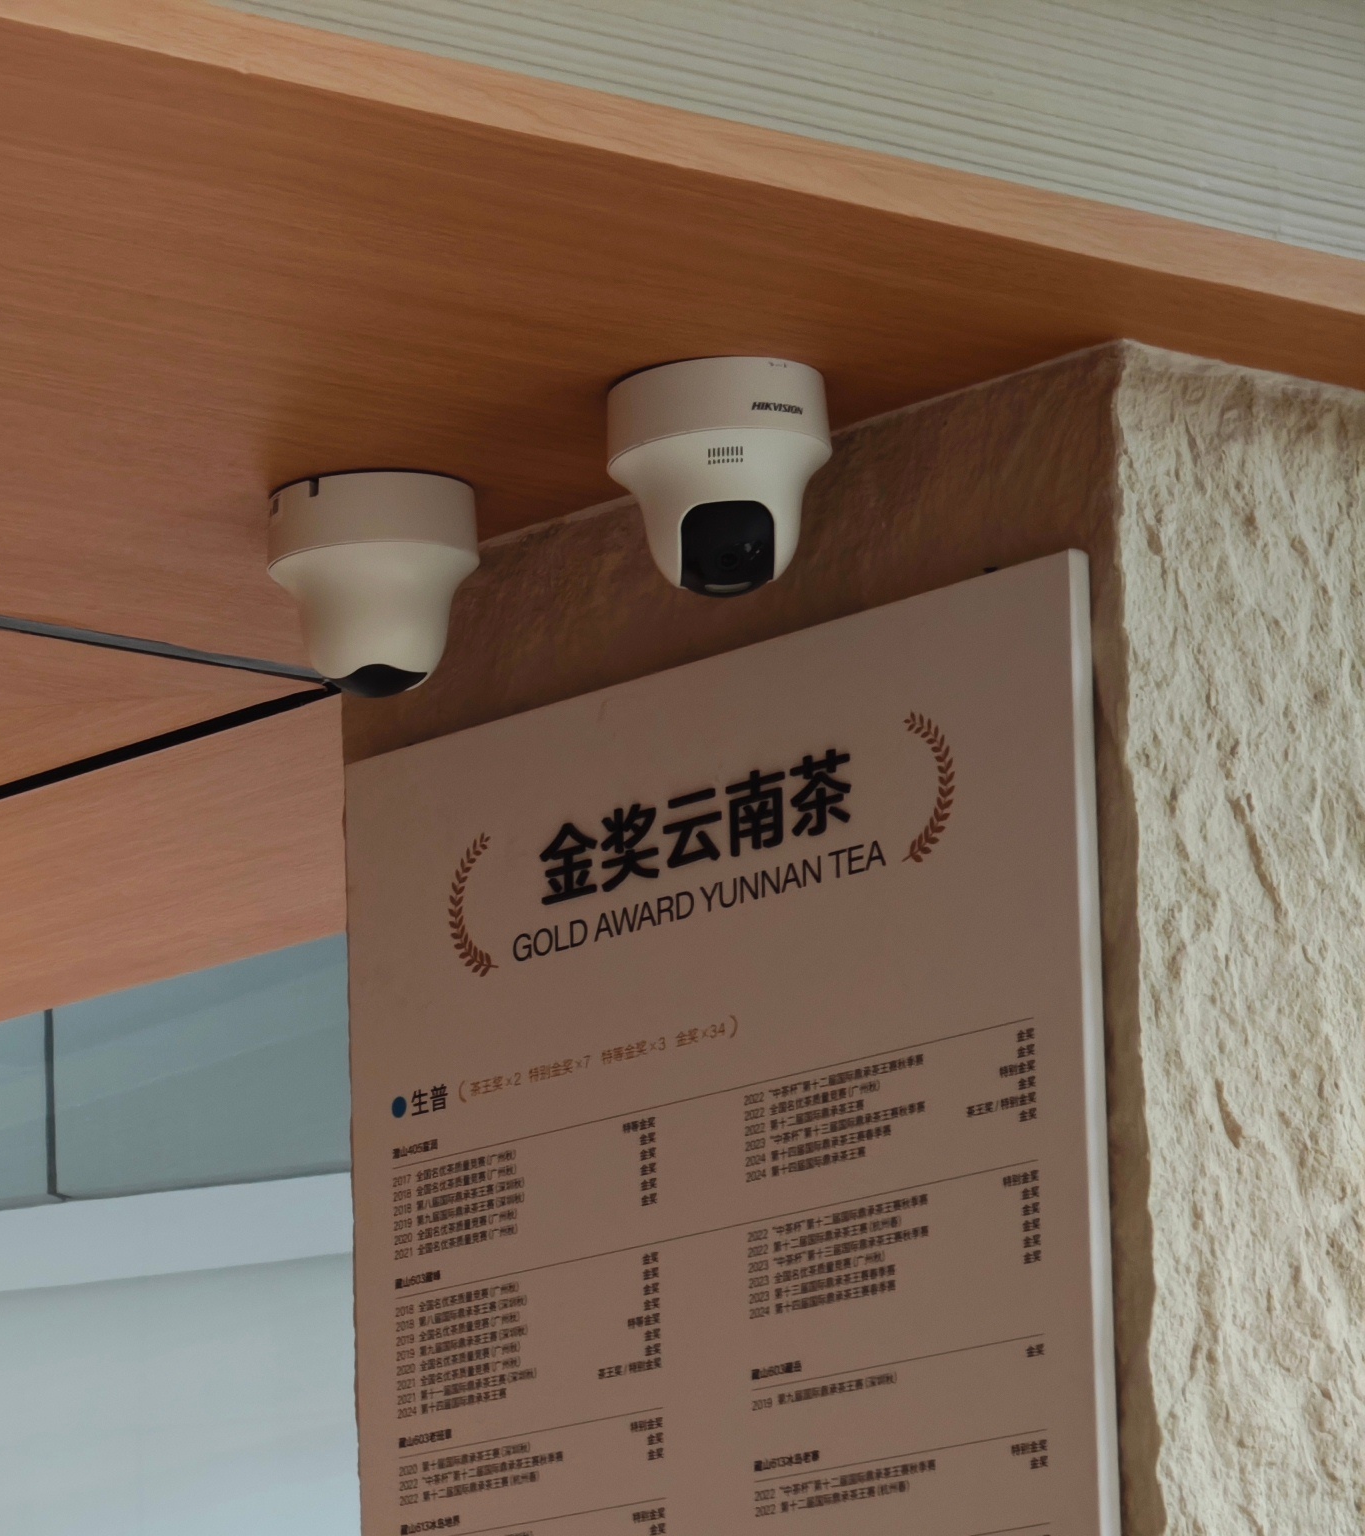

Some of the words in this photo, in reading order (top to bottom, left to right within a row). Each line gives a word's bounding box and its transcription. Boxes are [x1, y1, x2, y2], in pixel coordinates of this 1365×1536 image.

[751, 401, 804, 416] HIKVISION
[540, 748, 852, 906] 金奖云南茶
[512, 919, 588, 962] GOLD
[594, 891, 694, 943] AWARD
[701, 855, 823, 913] YUNNAN
[830, 840, 886, 878] TEA
[1015, 1026, 1035, 1043] 金奖
[410, 1083, 448, 1117] 生普
